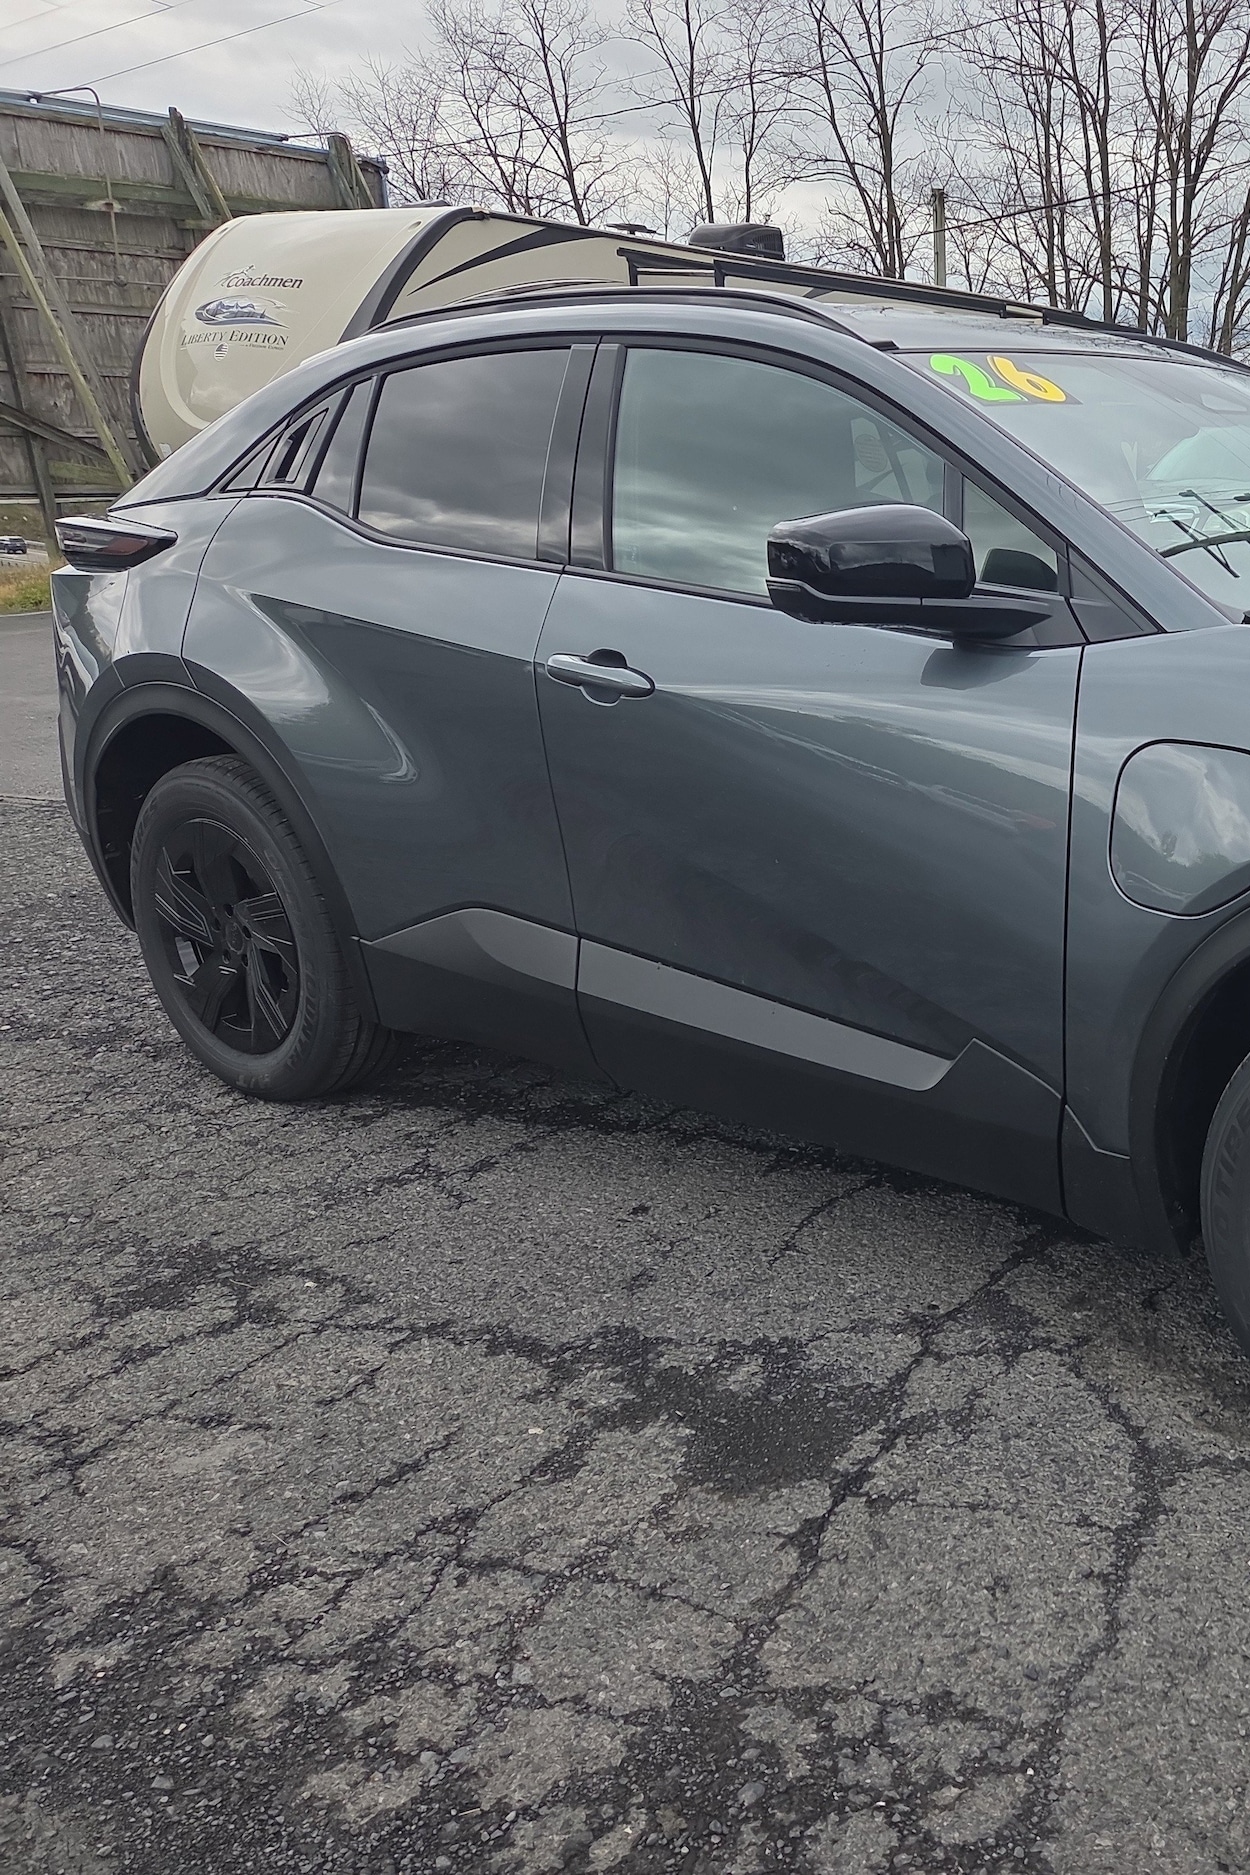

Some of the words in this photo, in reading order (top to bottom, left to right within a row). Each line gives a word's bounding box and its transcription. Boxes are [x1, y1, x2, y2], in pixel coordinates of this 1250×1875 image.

[226, 273, 303, 289] Coachmen
[181, 331, 227, 346] LIBERTY
[229, 329, 289, 346] EDITION
[929, 353, 1067, 402] 26
